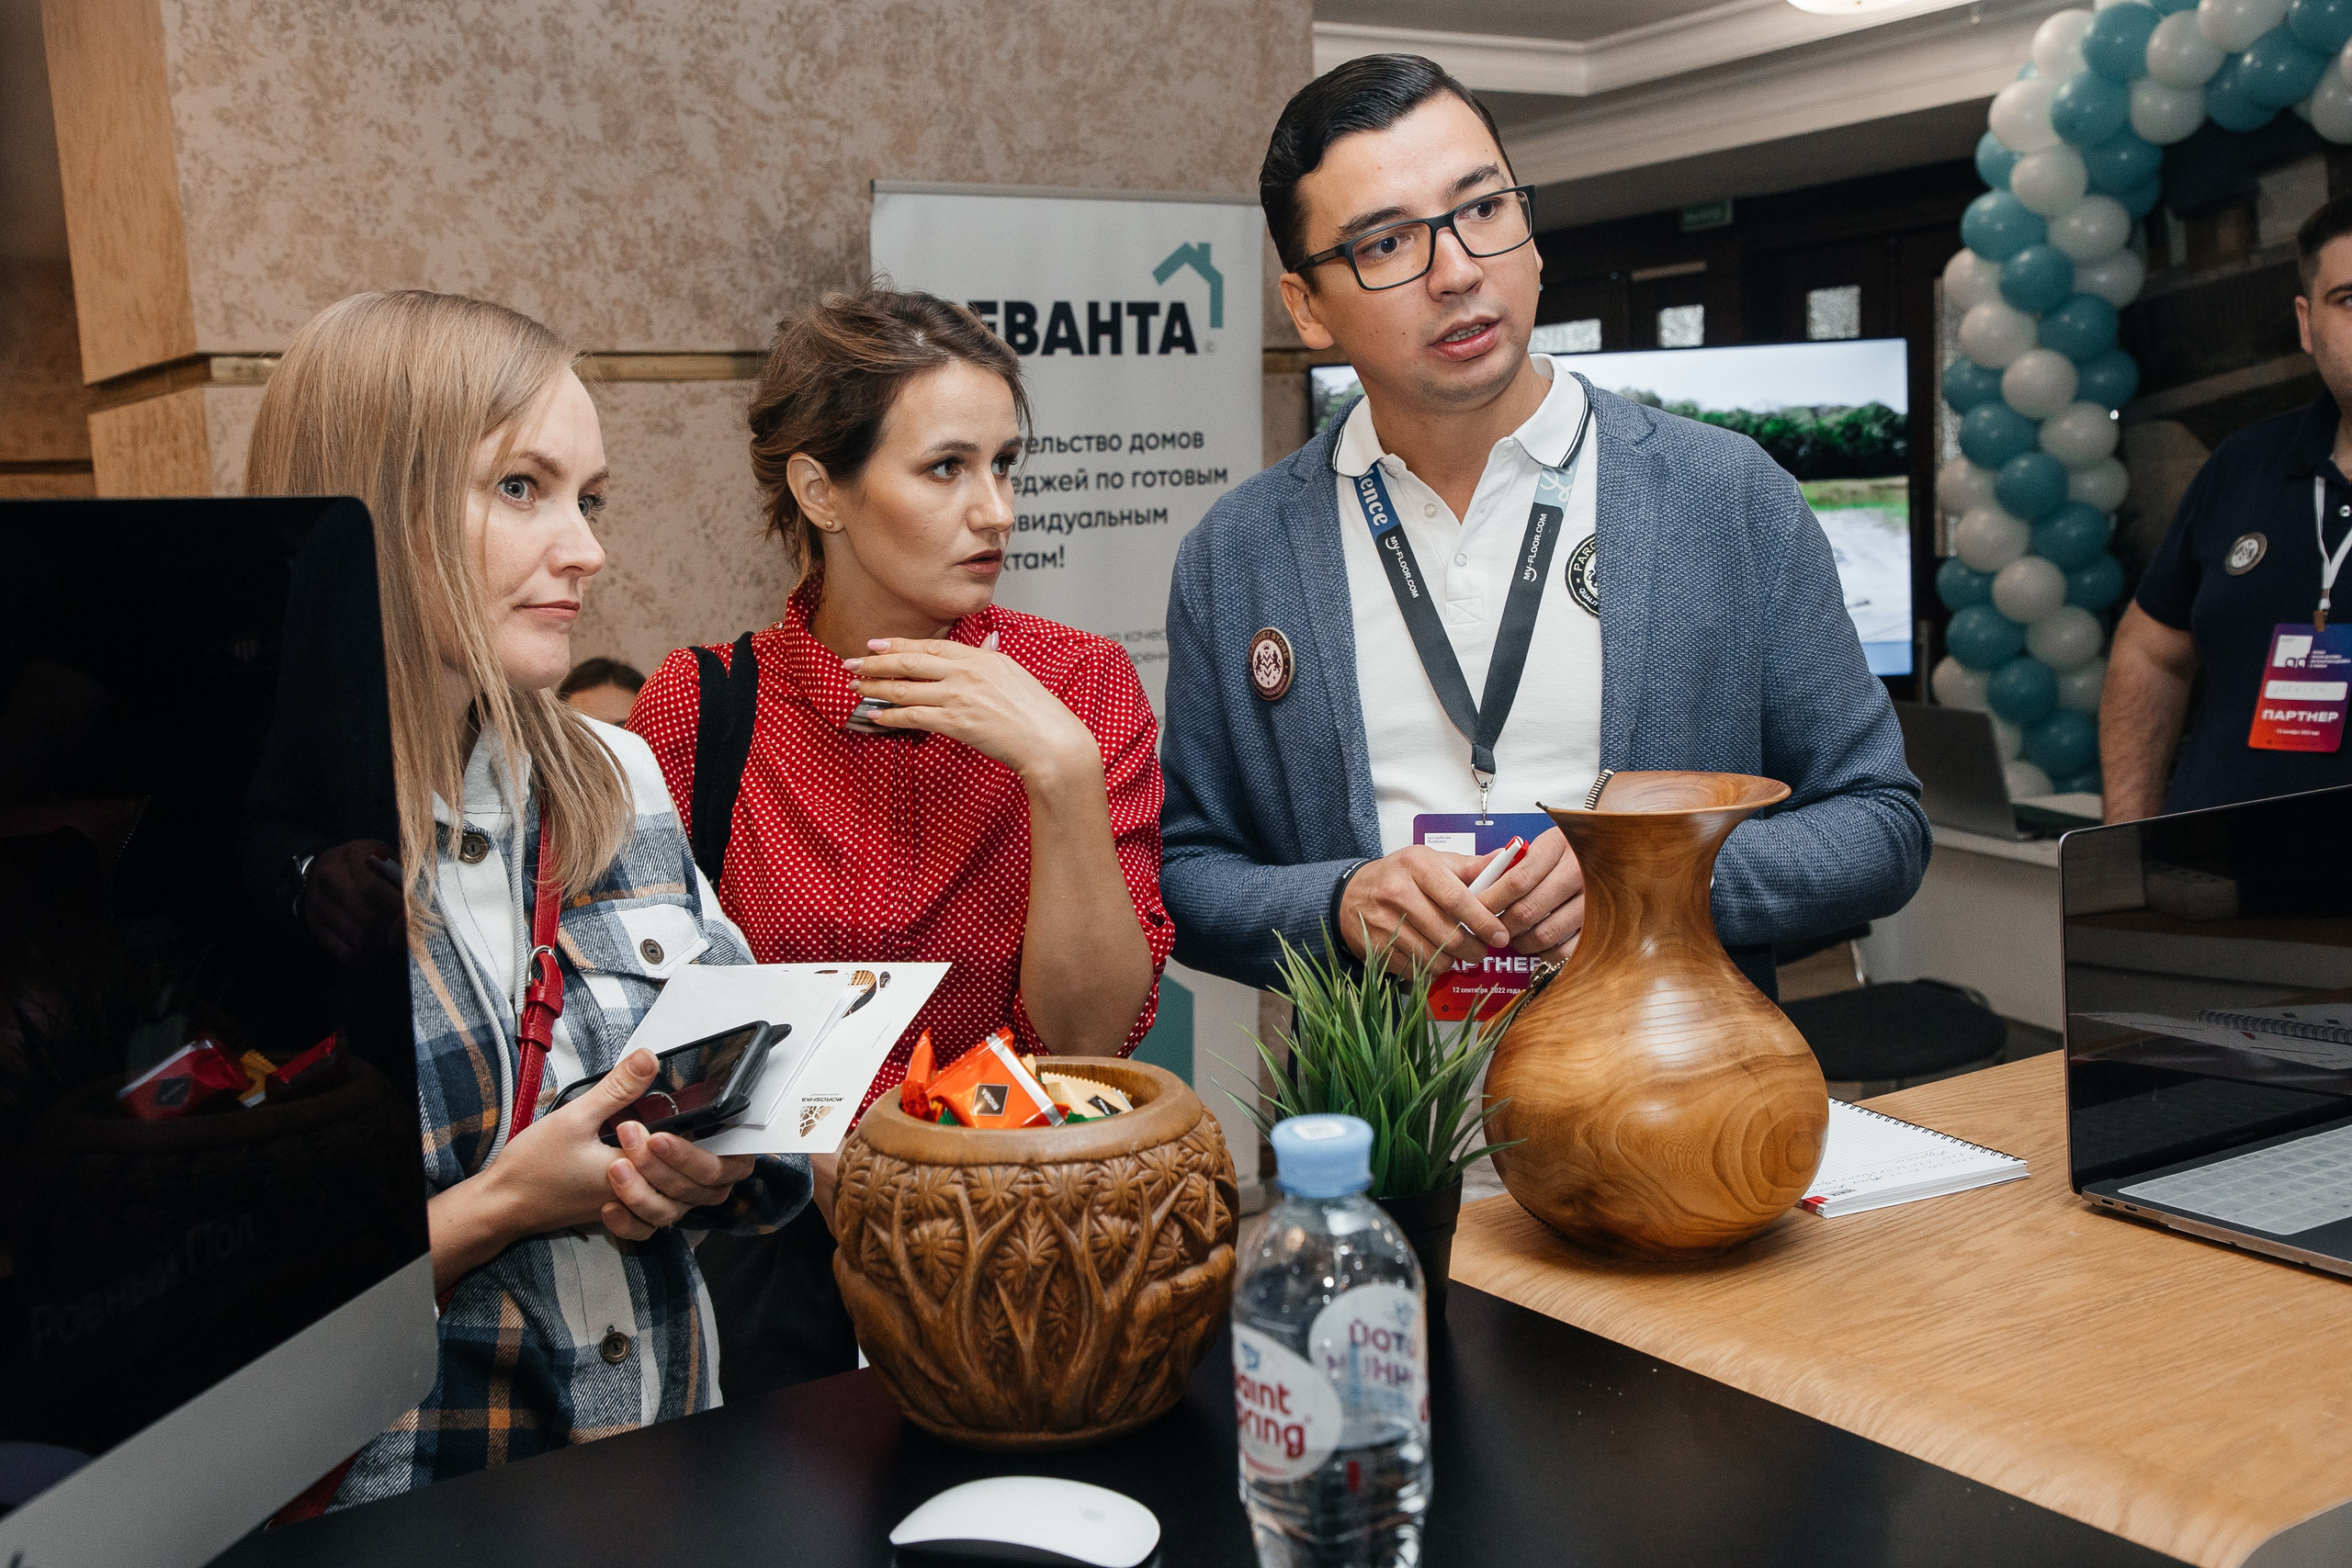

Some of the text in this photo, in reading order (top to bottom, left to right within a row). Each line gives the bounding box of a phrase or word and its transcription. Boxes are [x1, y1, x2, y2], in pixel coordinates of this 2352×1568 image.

[1023, 431, 1205, 455] ельство домов
[1096, 471, 1125, 490] по
[1131, 467, 1228, 489] готовым
[1272, 632, 1289, 660] STORE
[2262, 708, 2339, 722] ПАРТНЕР
[1237, 1402, 1306, 1460] ring
